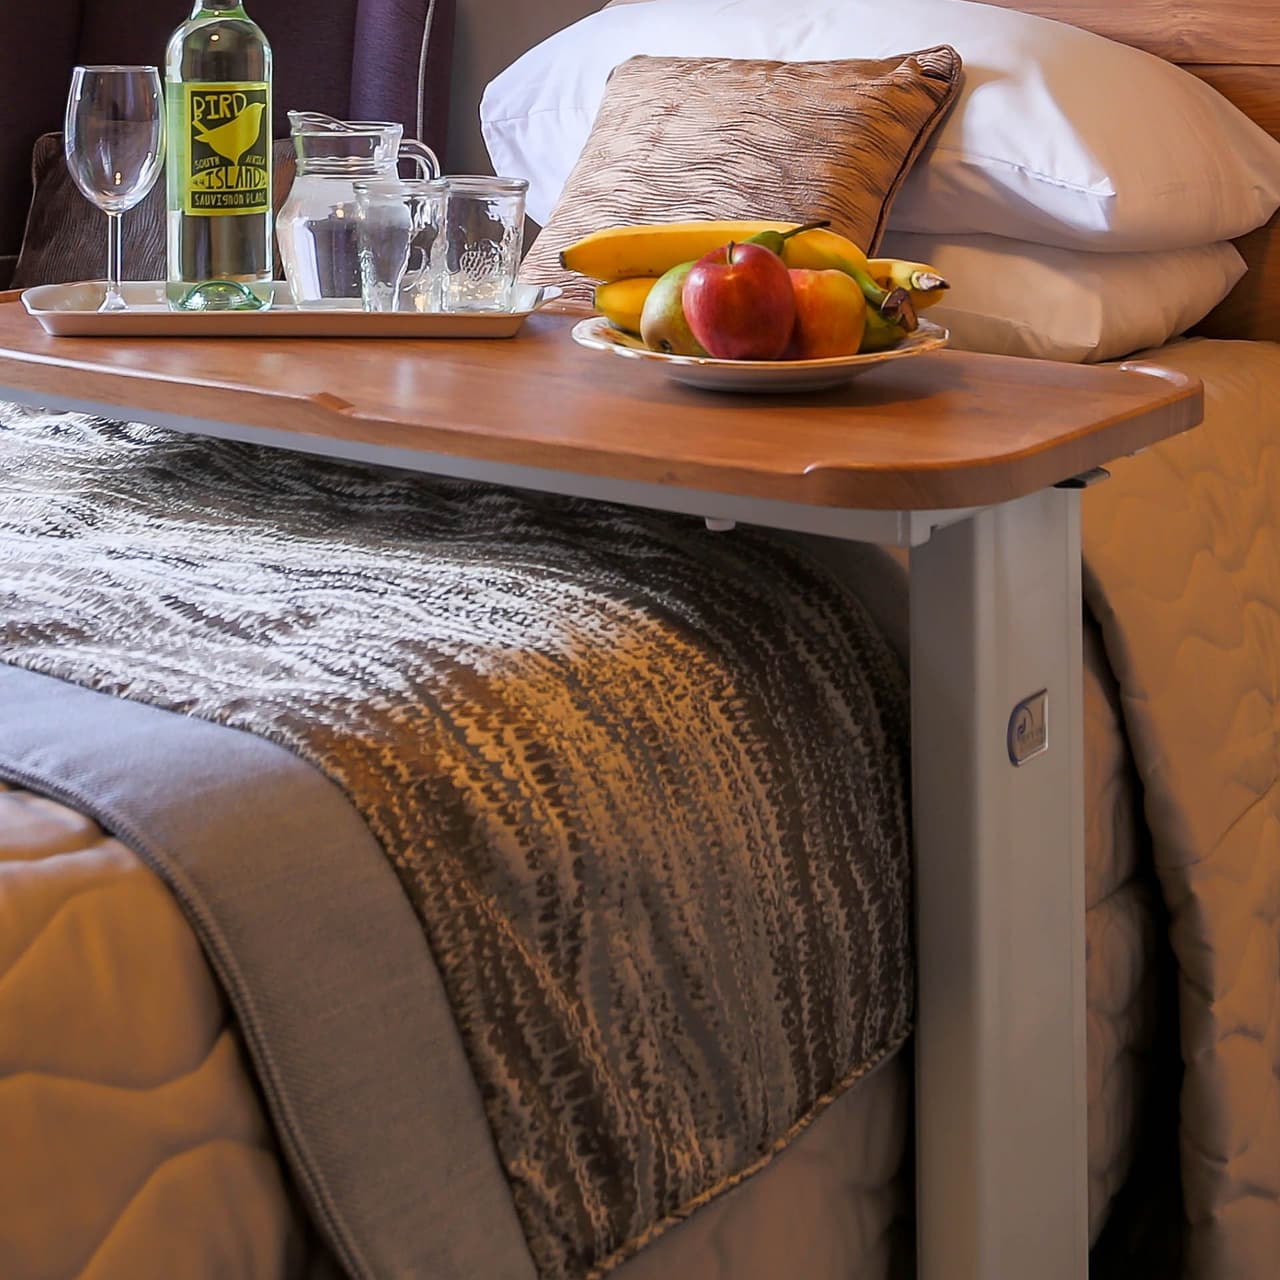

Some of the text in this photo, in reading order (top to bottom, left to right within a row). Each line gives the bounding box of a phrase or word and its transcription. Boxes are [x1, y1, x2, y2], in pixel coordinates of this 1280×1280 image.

[193, 93, 247, 120] BIRD
[194, 156, 220, 169] SOUTH
[205, 166, 261, 189] ISLAND
